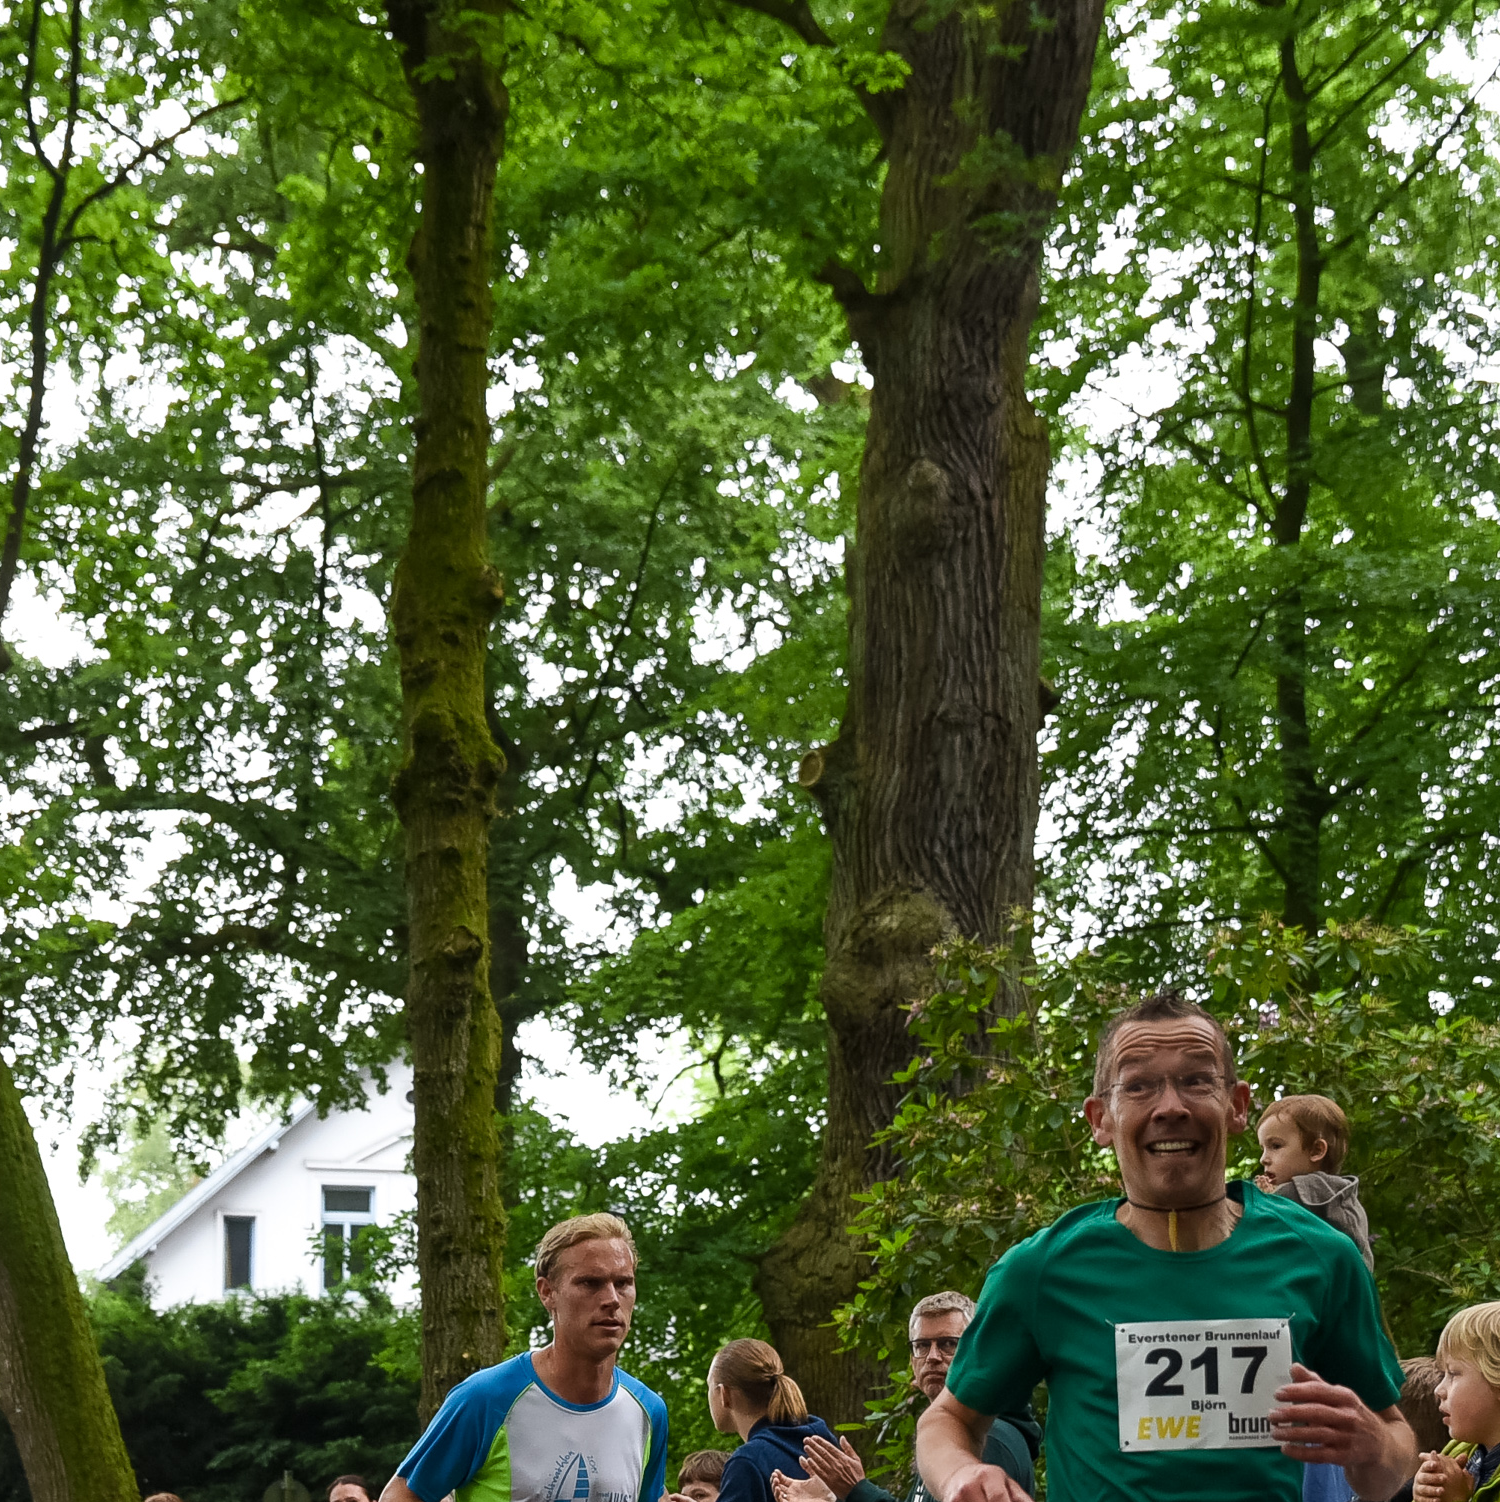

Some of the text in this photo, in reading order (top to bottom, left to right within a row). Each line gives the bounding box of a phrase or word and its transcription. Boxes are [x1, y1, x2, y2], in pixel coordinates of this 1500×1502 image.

[1128, 1329, 1280, 1344] Everstener Brunnenlauf
[1144, 1345, 1268, 1397] 217
[1191, 1400, 1227, 1413] Björn
[1137, 1414, 1201, 1440] EWE
[1228, 1412, 1271, 1434] brun
